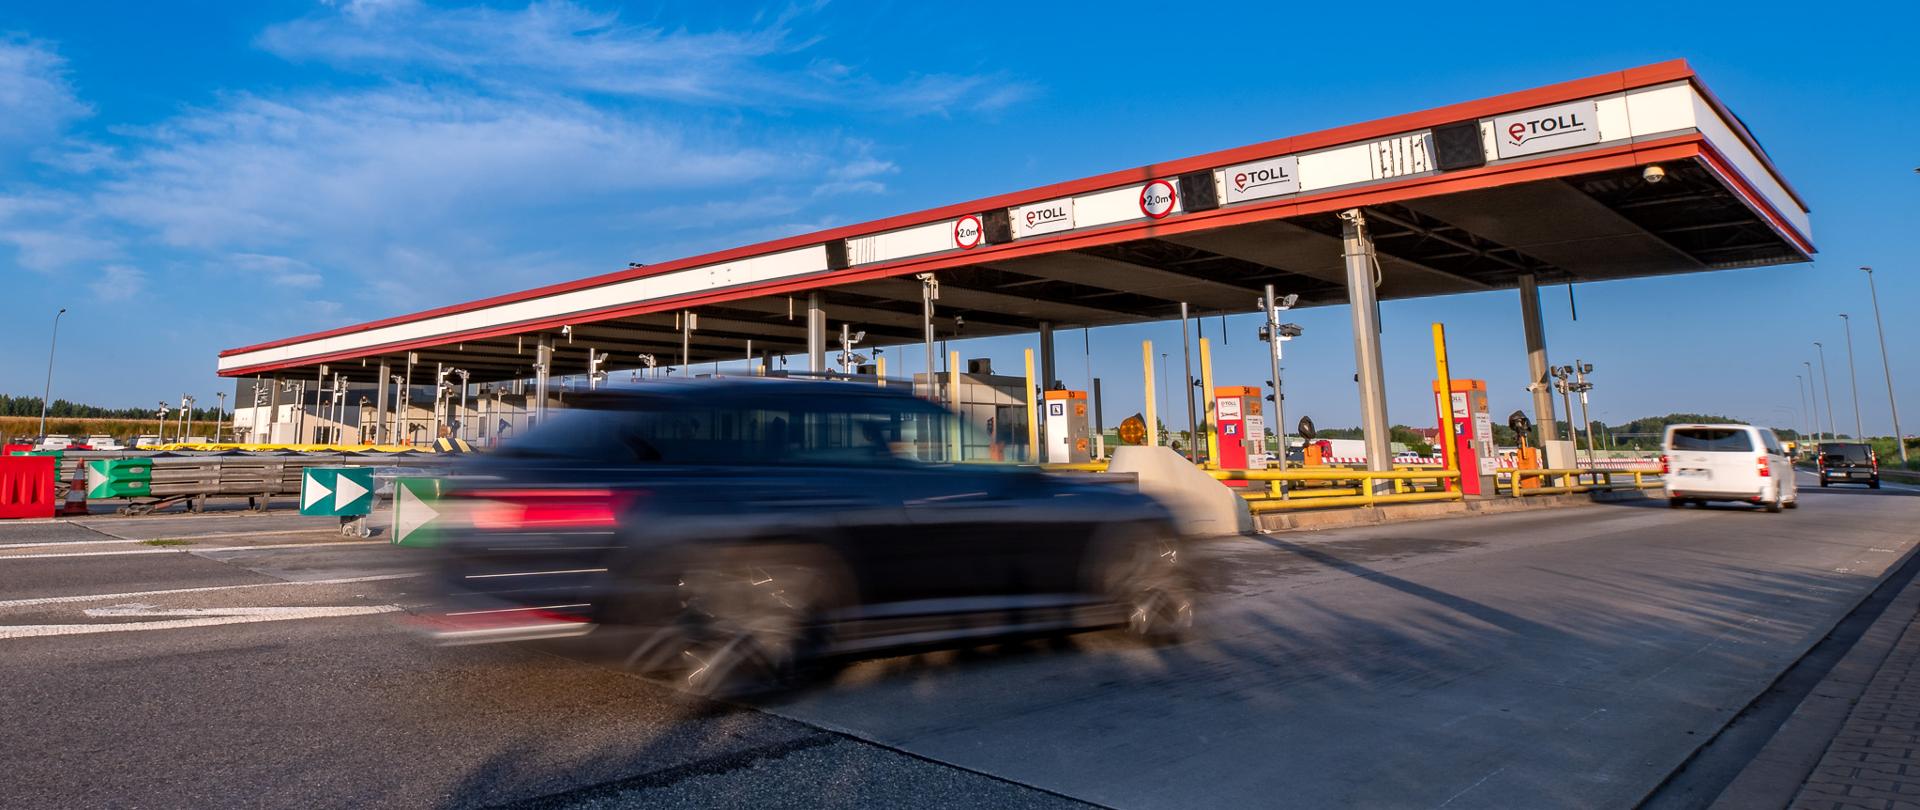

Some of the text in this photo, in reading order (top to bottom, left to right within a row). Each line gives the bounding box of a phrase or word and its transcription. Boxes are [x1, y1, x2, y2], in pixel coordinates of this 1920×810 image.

[1509, 114, 1584, 142] eTOLL
[1235, 167, 1289, 189] eTOLL
[1026, 207, 1066, 225] eTOLL
